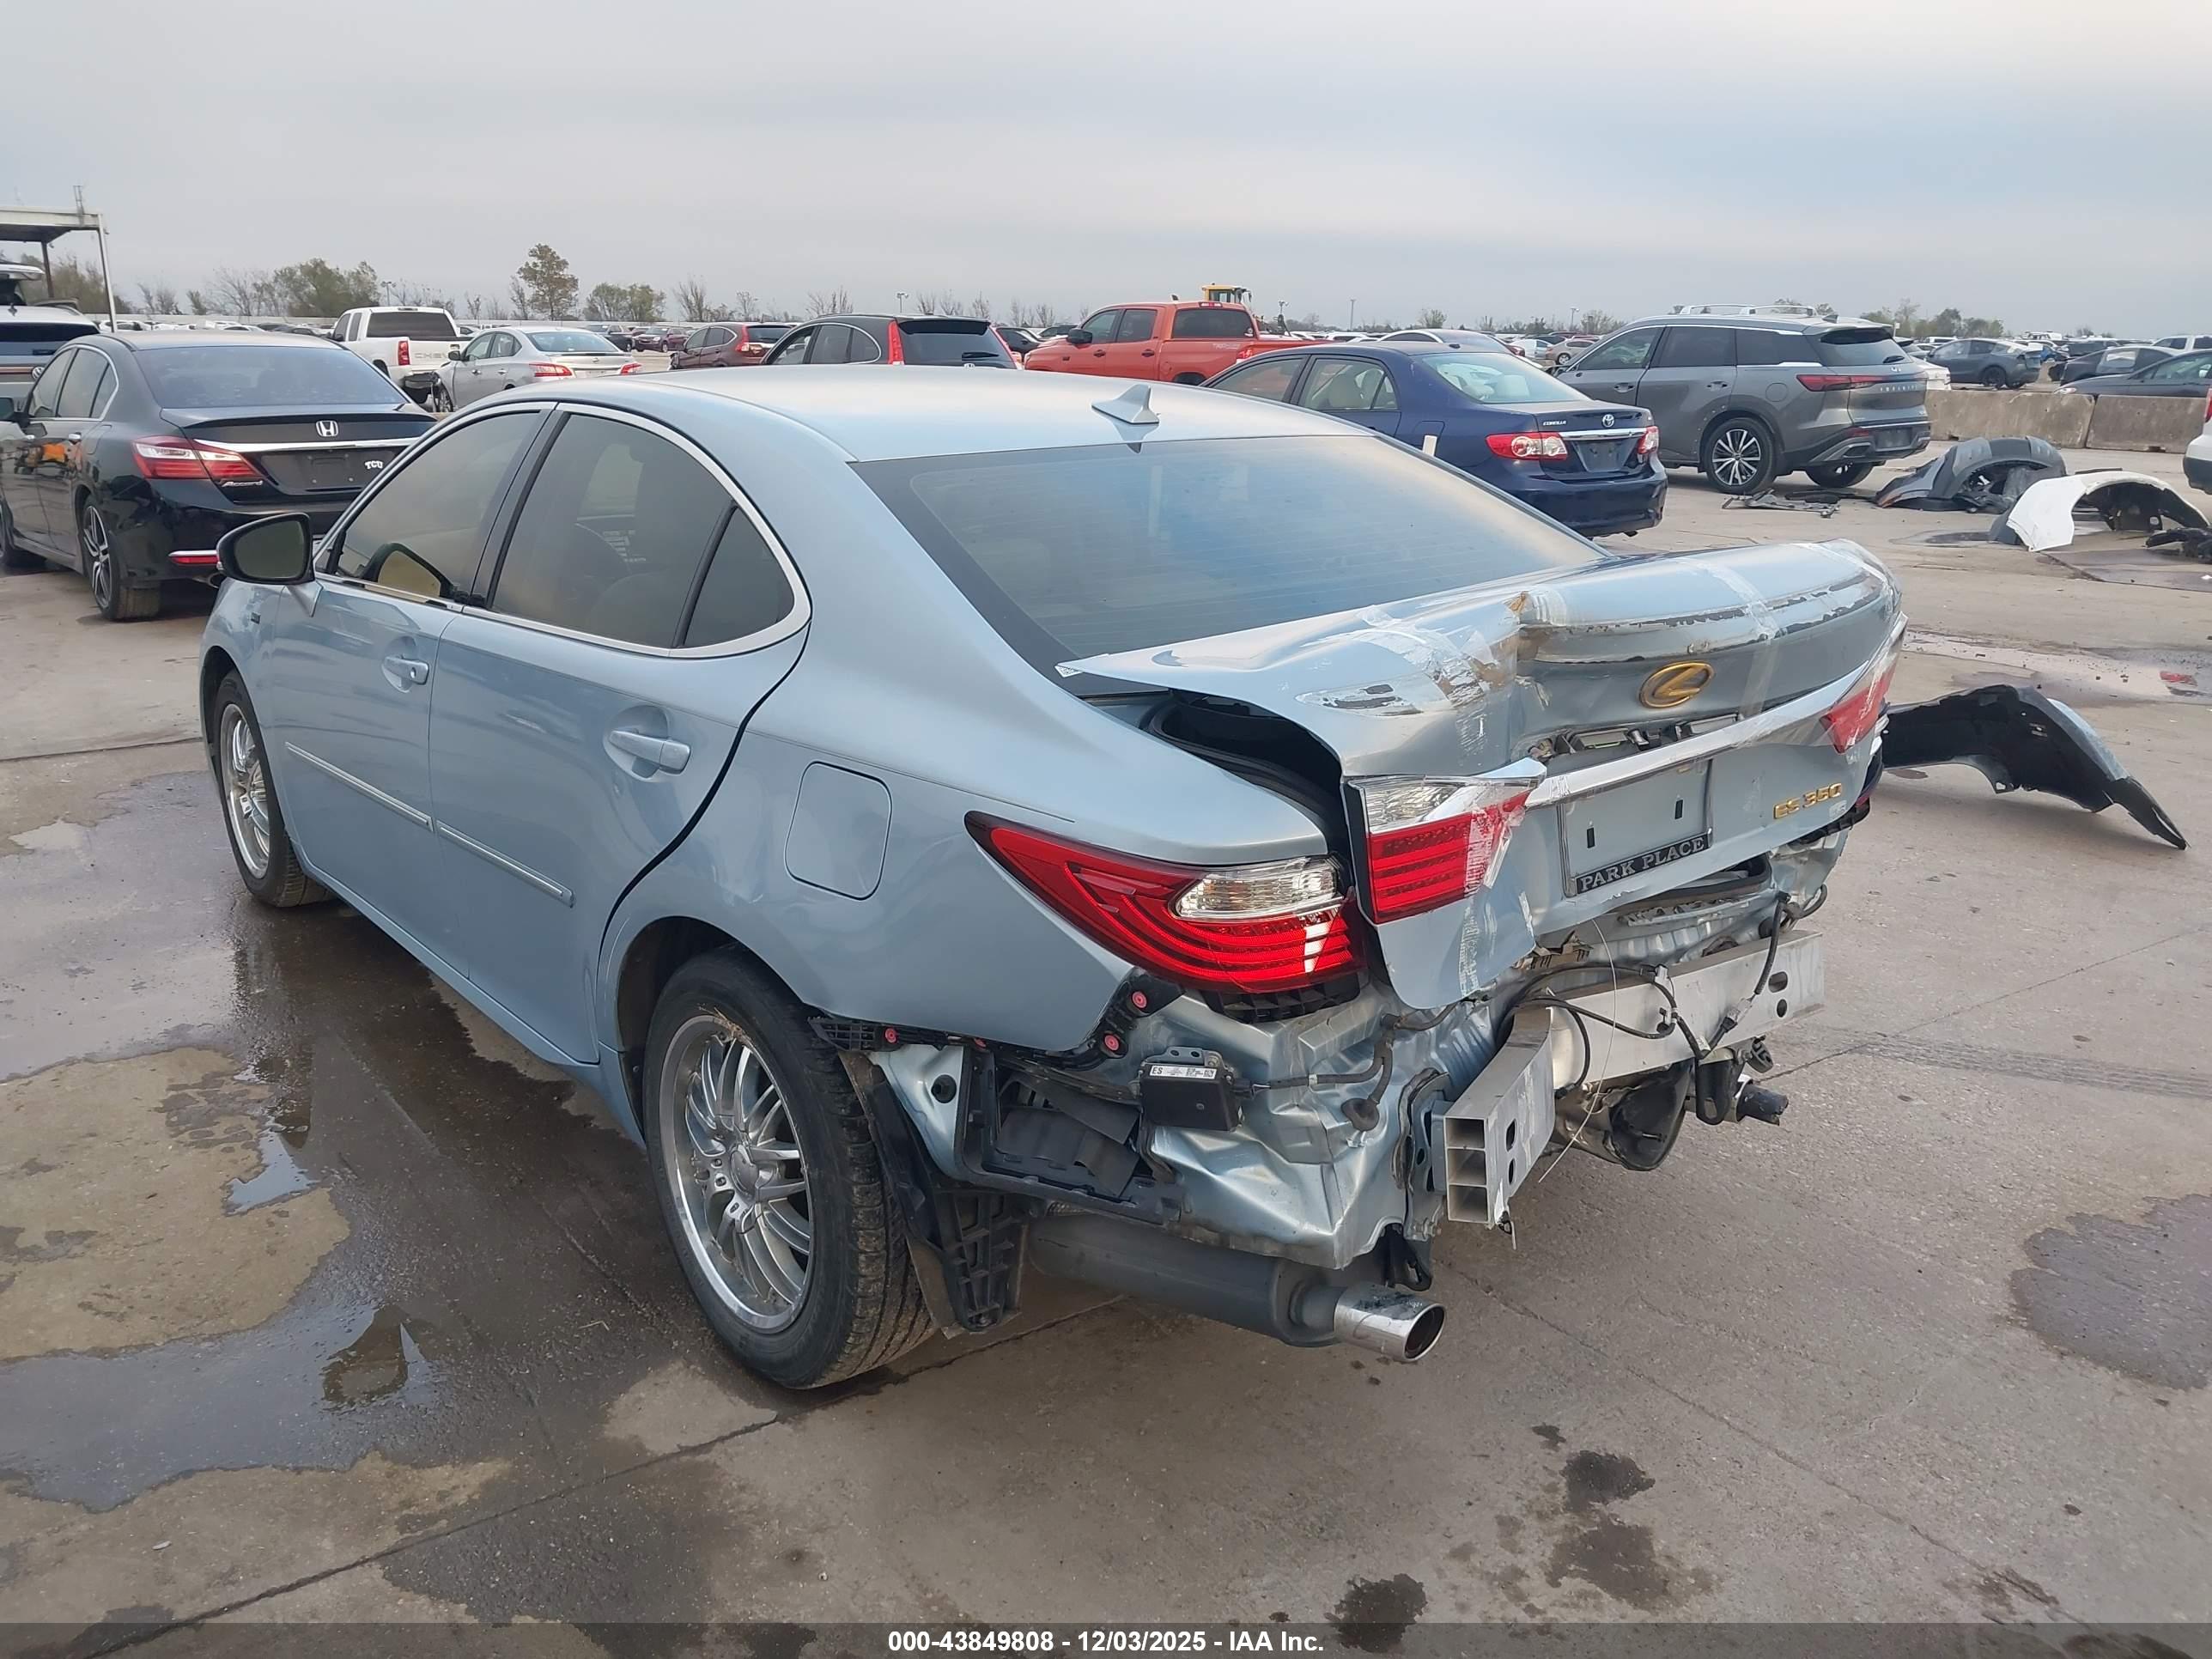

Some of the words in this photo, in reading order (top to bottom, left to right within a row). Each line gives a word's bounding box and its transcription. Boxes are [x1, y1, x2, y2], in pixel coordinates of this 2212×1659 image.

[364, 460, 384, 470] TCU
[1773, 797, 1801, 819] ES
[1802, 782, 1842, 808] 350
[1580, 859, 1636, 892] PARK
[1642, 836, 1705, 869] PLACE
[1152, 1066, 1164, 1075] ES
